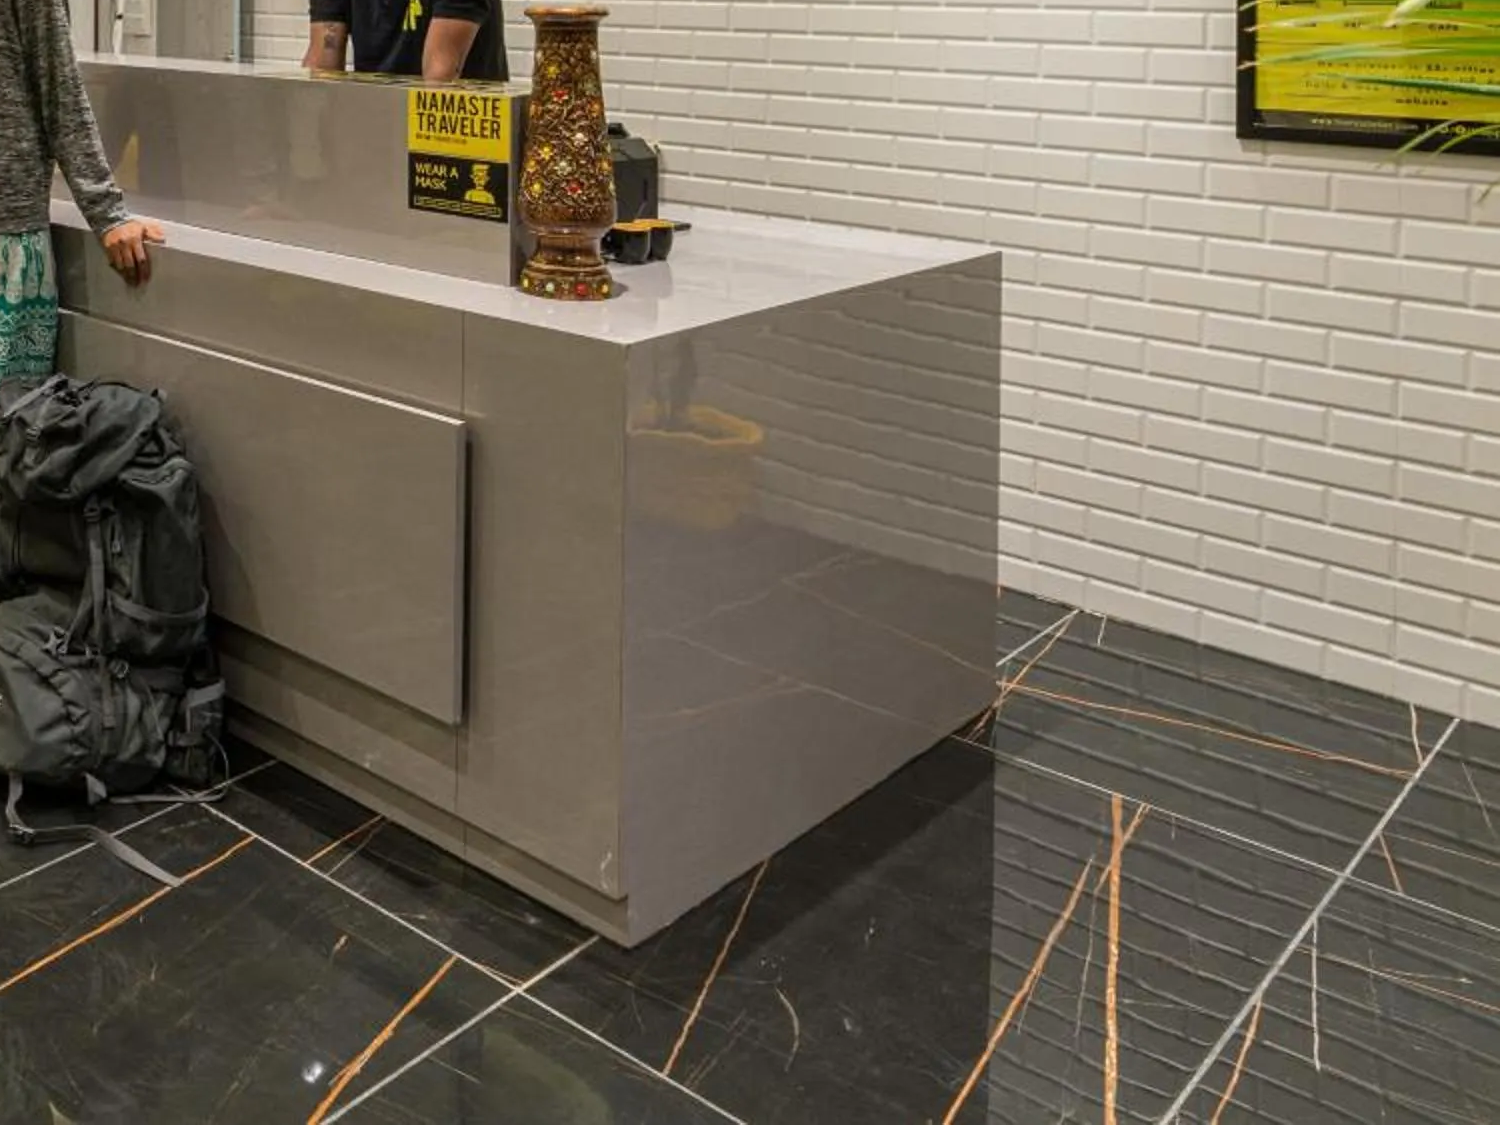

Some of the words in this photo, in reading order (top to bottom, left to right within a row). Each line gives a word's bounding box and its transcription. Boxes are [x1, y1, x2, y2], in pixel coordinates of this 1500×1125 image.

[417, 90, 501, 119] NAMASTE
[417, 112, 501, 140] TRAVELER
[415, 162, 448, 178] WEAR
[450, 166, 459, 180] A
[415, 176, 447, 191] MASK
